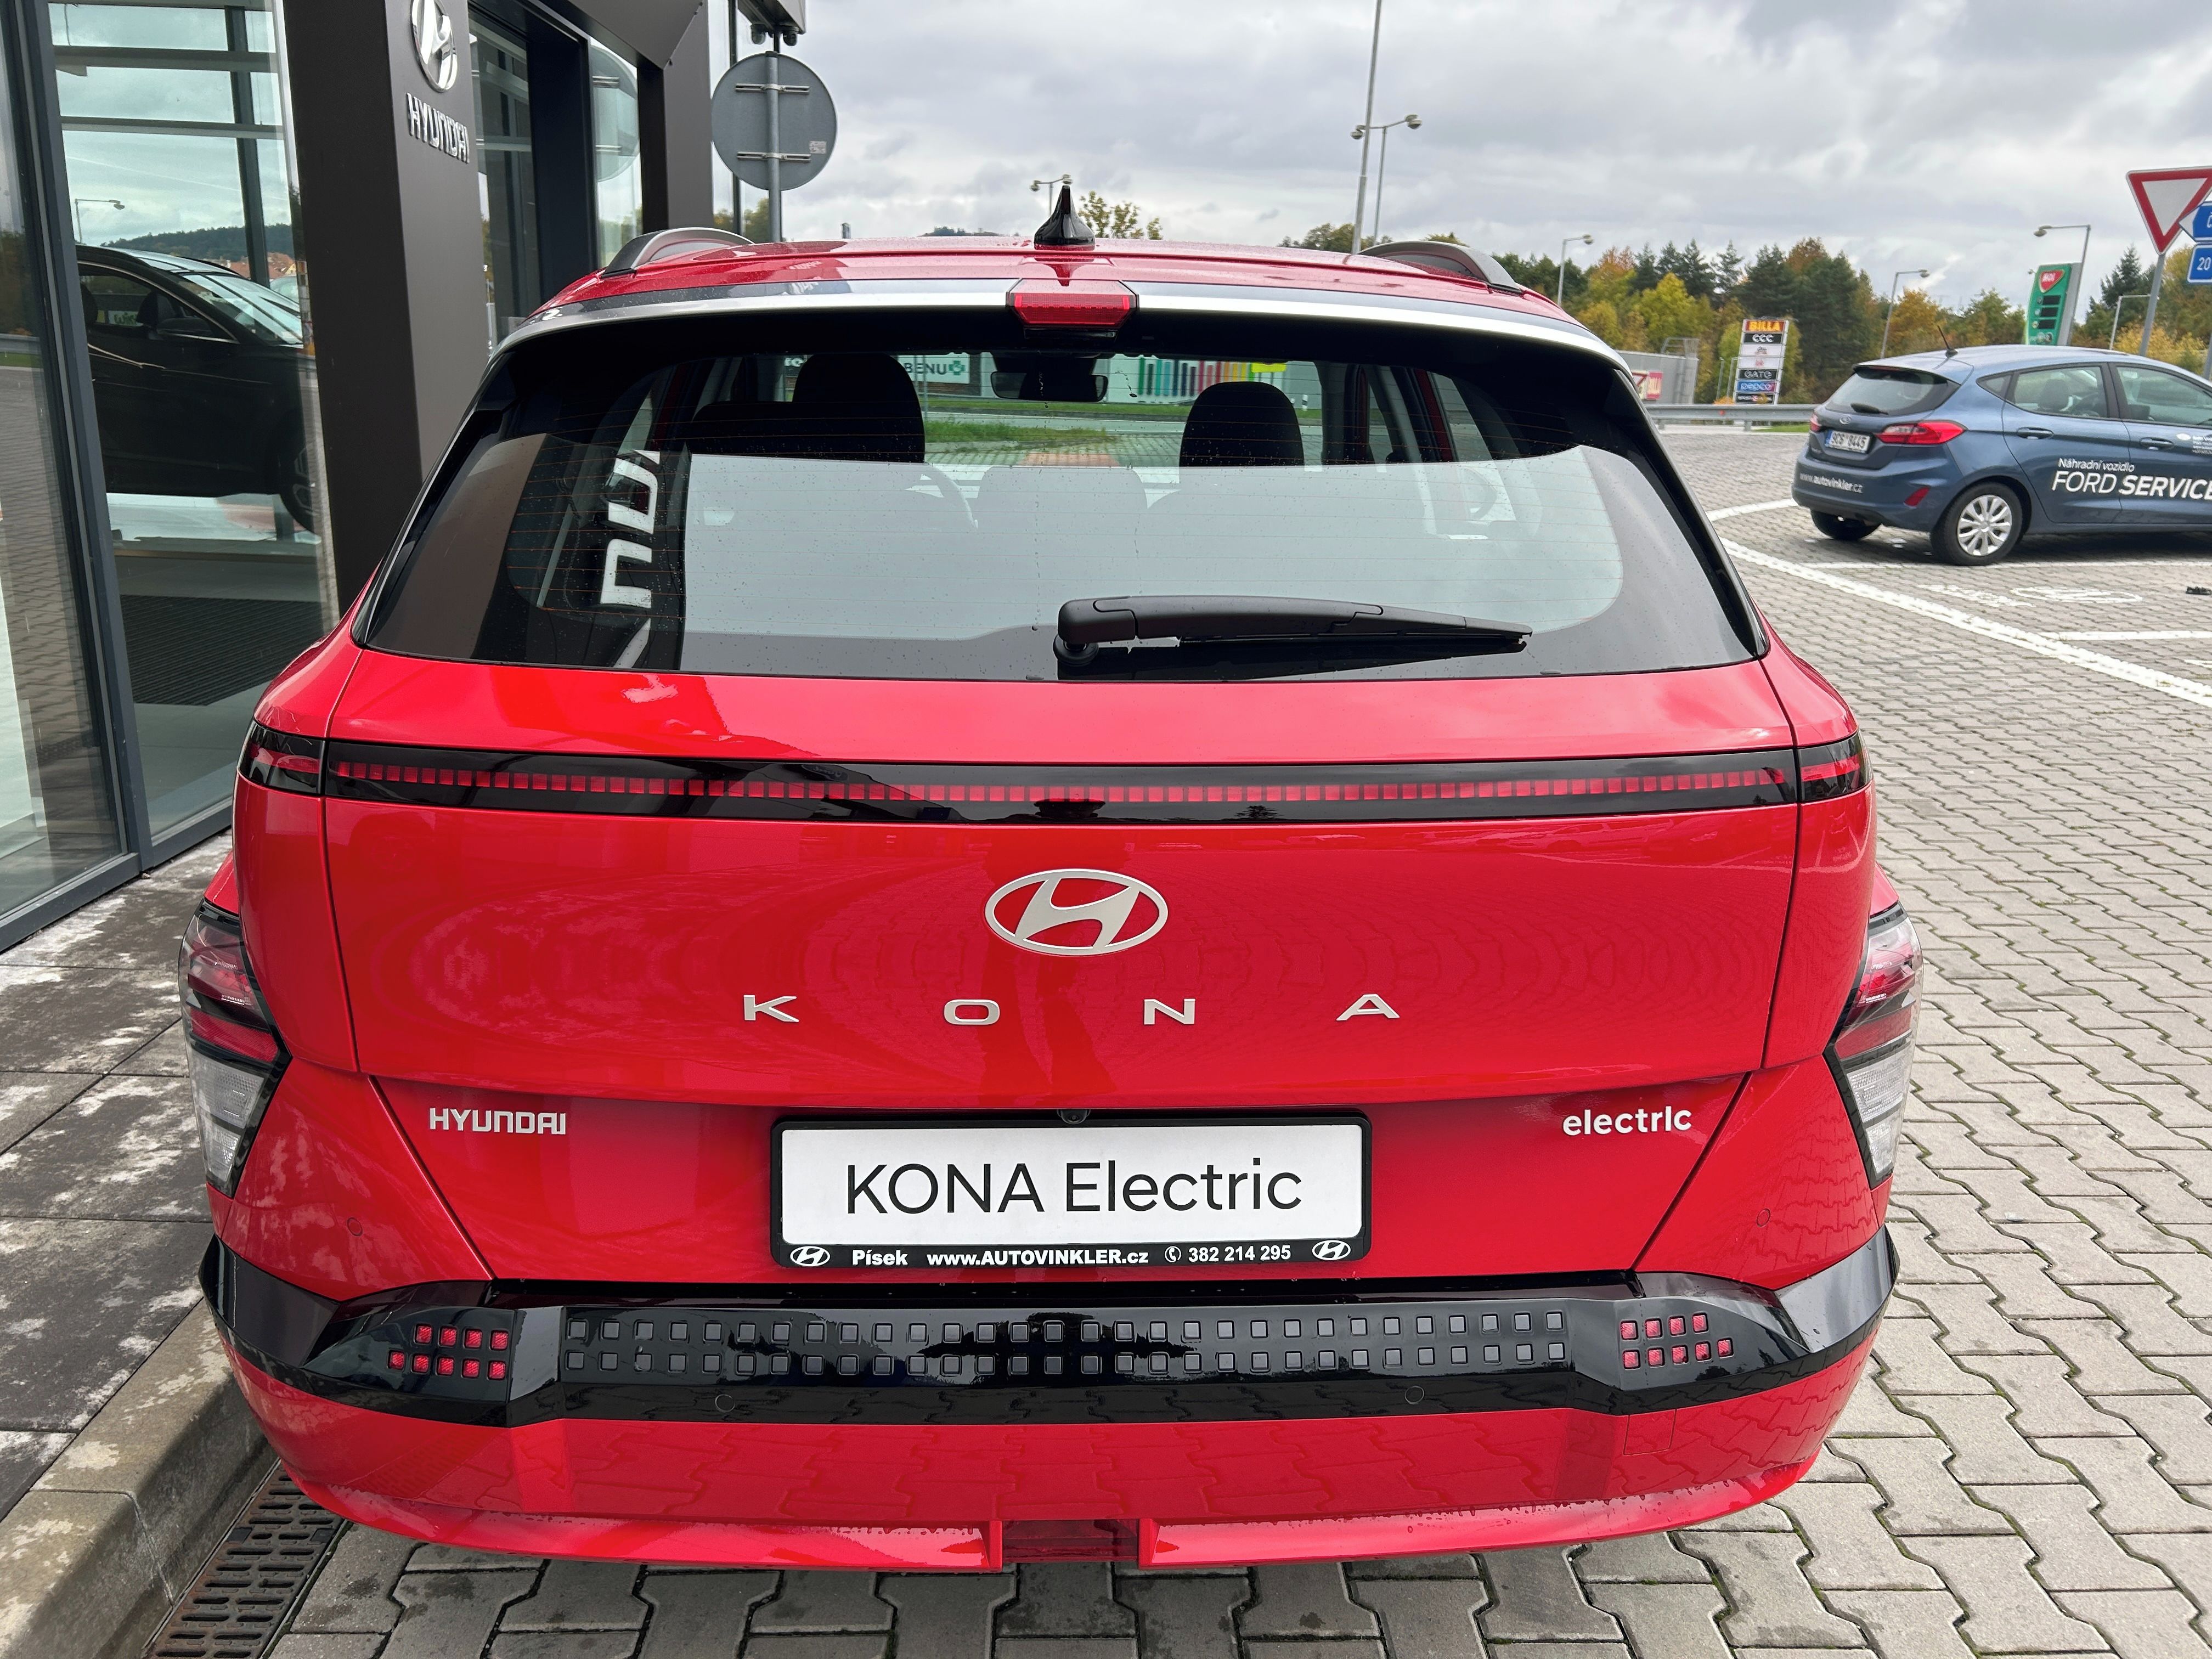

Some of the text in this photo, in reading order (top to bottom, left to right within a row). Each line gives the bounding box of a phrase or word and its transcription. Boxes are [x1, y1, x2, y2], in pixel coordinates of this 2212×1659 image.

[406, 92, 470, 163] HYUNDAI
[1748, 320, 1780, 331] BILLA
[1752, 334, 1774, 343] CCC
[904, 363, 947, 375] BENU
[2058, 458, 2135, 473] Náhradní vozidlo
[2051, 470, 2117, 494] FORD
[430, 1108, 566, 1135] HYUNDAI
[1563, 1105, 1692, 1136] electric
[848, 1157, 1302, 1214] KONA Electric
[852, 1245, 1291, 1266] Písek www.AUTOVINKLER.cz 382 214 295
